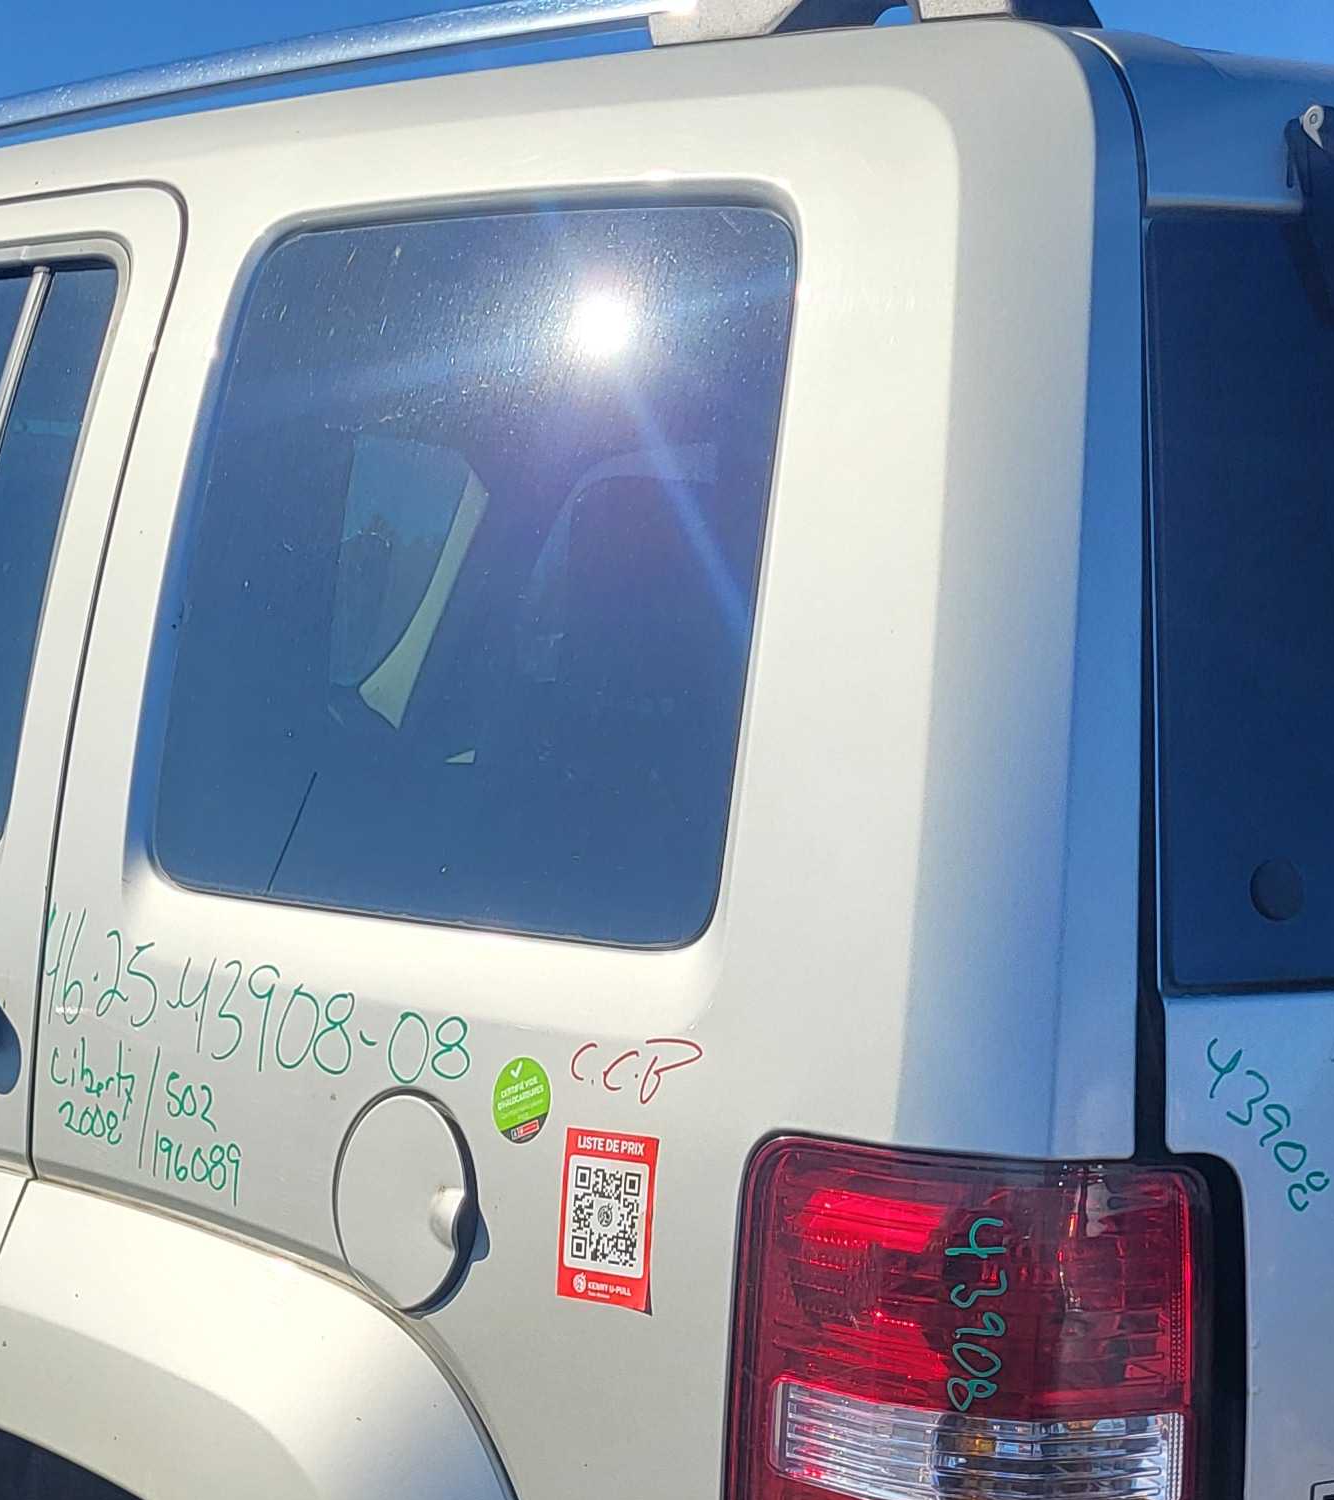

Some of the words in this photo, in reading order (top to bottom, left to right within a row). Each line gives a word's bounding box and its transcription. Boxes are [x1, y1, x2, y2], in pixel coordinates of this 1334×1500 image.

[58, 1100, 123, 1145] 2008
[577, 1134, 605, 1152] LISTE
[605, 1138, 621, 1153] DE
[620, 1140, 646, 1157] PRIX
[1206, 1036, 1331, 1213] 43908
[152, 1128, 242, 1207] 196089
[944, 1216, 1008, 1413] 43908
